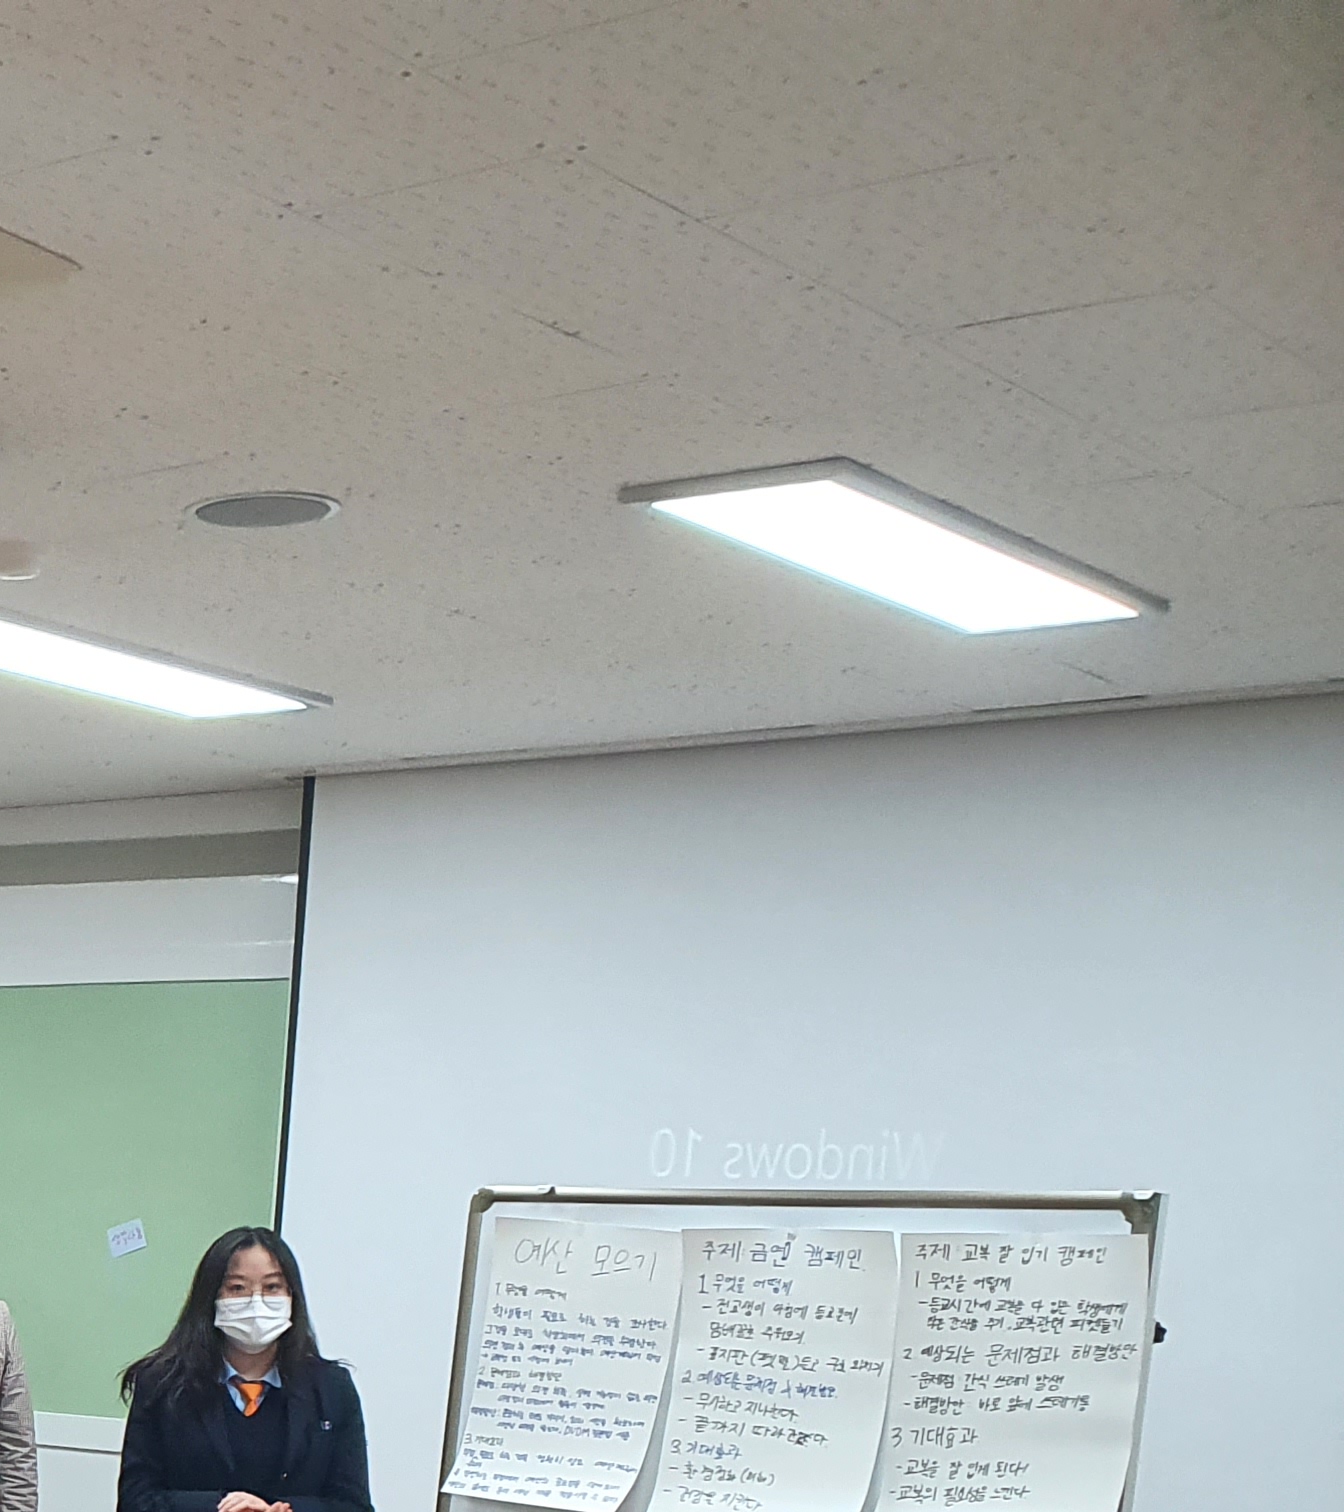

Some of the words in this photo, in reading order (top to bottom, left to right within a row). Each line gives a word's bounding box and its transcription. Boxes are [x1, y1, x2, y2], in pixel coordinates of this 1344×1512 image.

[514, 1237, 573, 1275] 예산
[590, 1244, 658, 1282] 모으기
[928, 1272, 967, 1293] 무엇을
[985, 1343, 1060, 1367] 문제점과
[890, 1426, 903, 1448] 3
[909, 1425, 980, 1450] 기대효과
